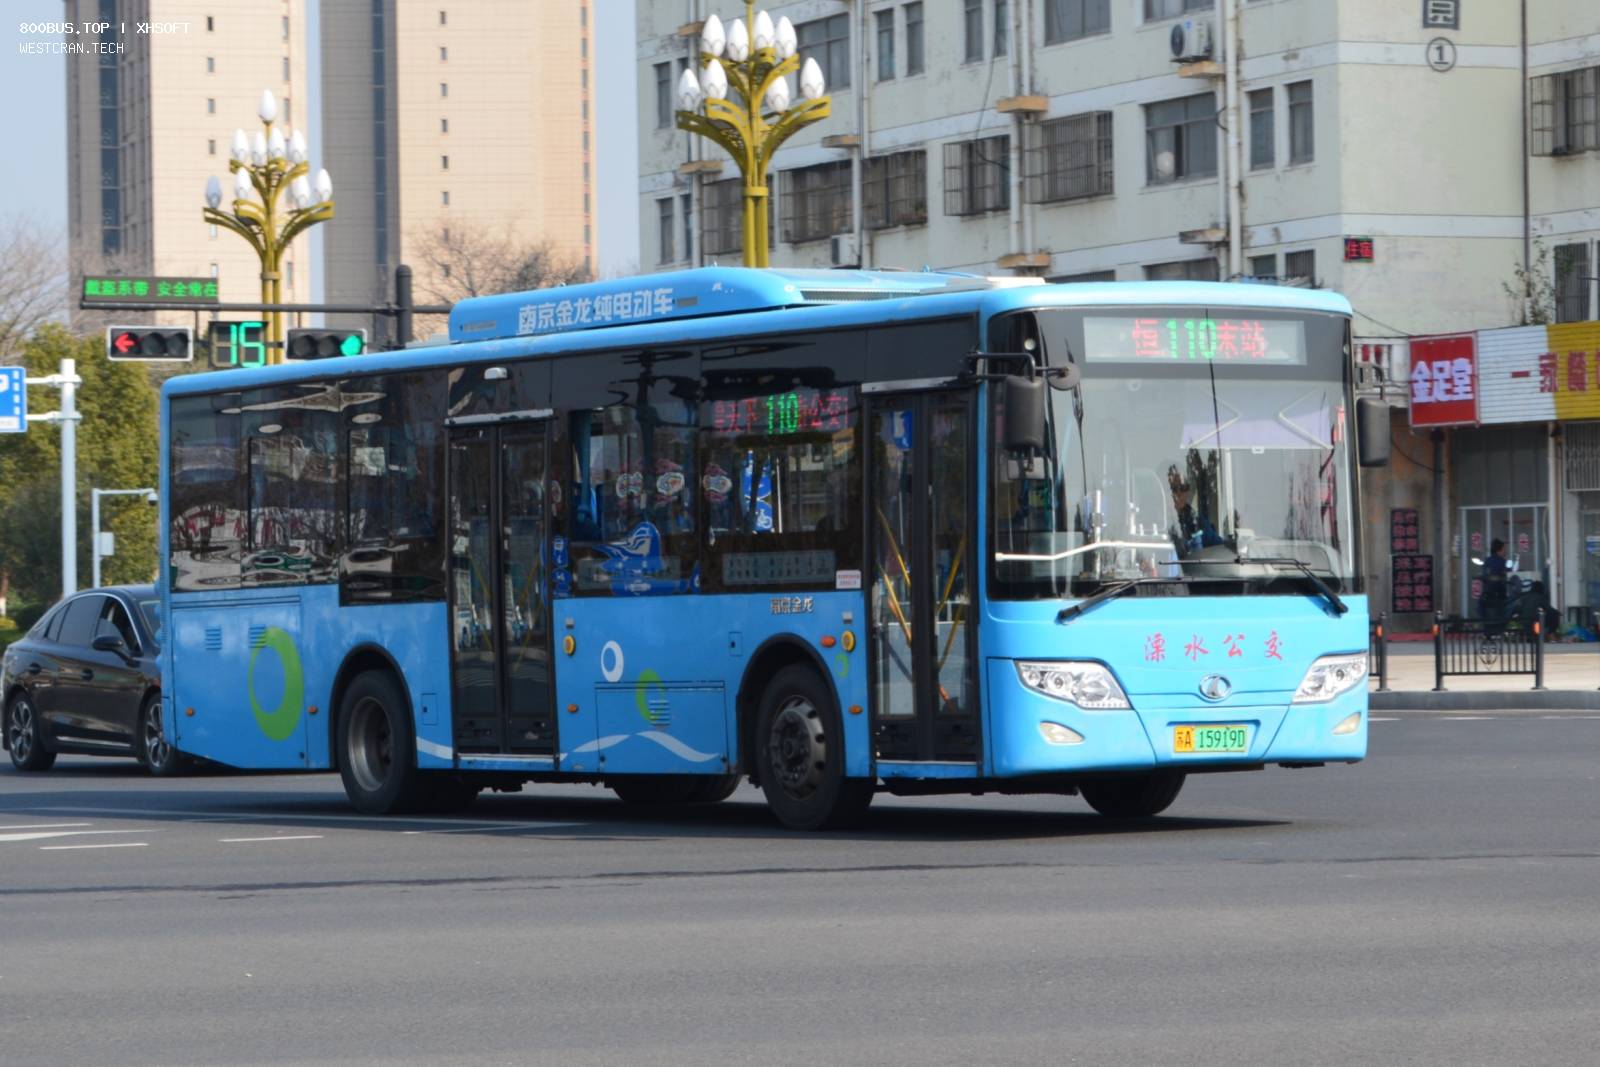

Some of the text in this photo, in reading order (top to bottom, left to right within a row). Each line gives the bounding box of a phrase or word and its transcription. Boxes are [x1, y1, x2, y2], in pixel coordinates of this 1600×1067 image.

[516, 287, 674, 336] 南京金龙纯电动车
[229, 321, 266, 368] 15
[1411, 358, 1474, 404] 金足堂
[1145, 630, 1283, 663] 溧水公交
[1199, 729, 1246, 748] 15919D
